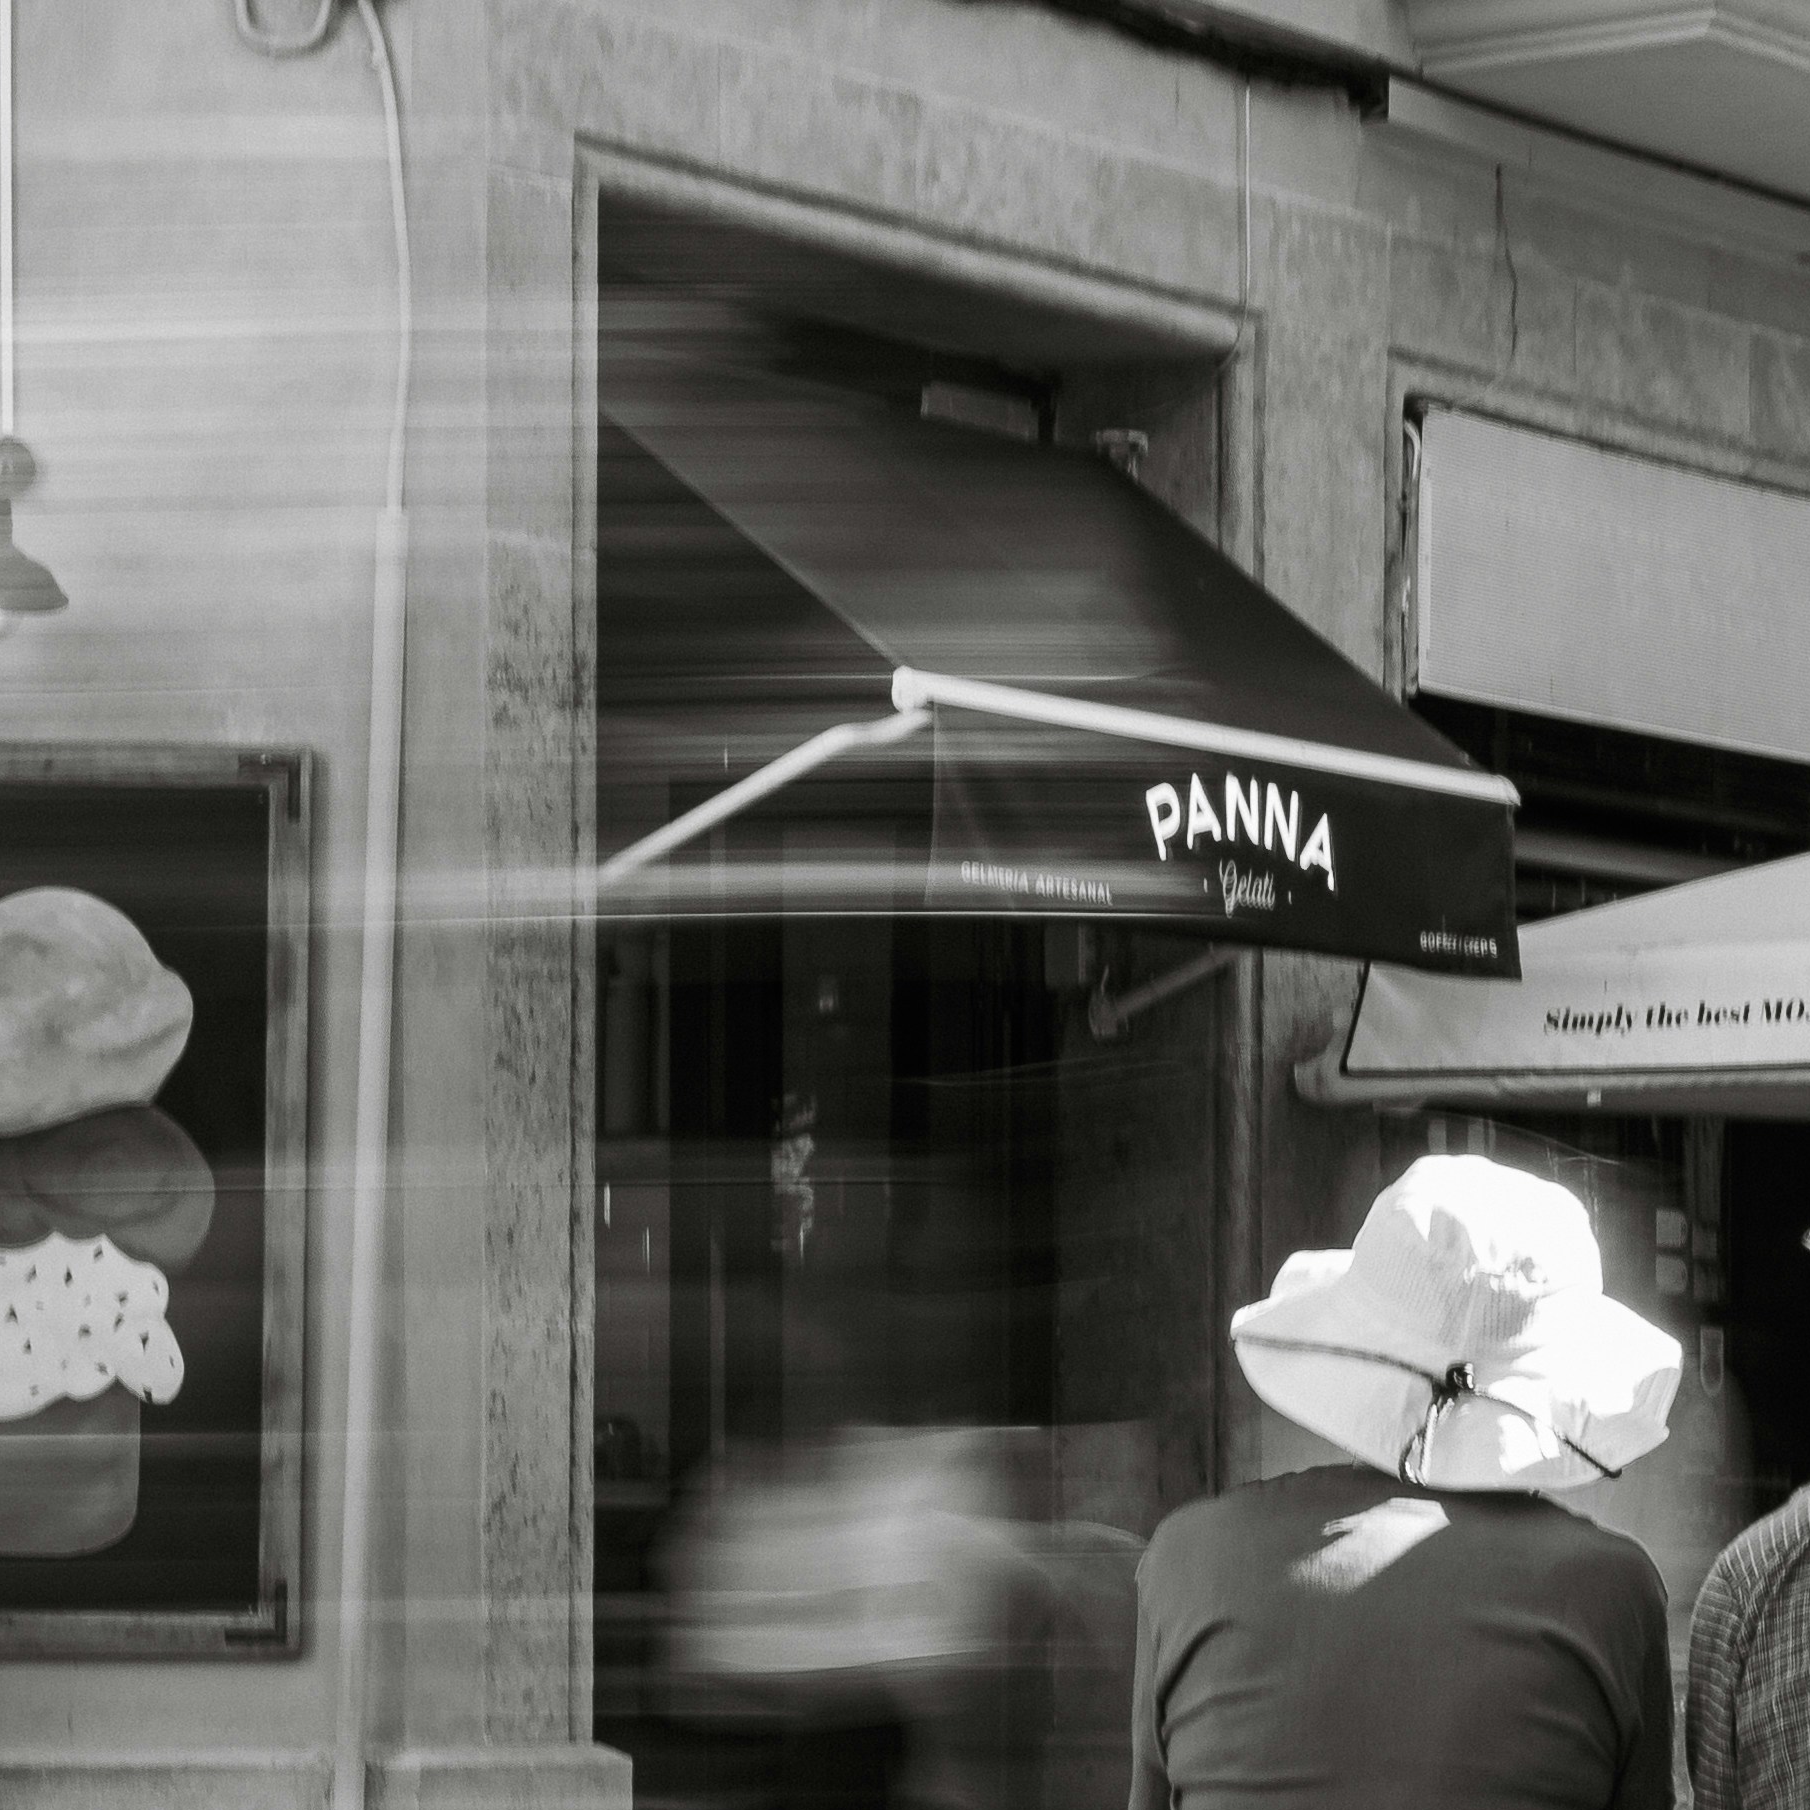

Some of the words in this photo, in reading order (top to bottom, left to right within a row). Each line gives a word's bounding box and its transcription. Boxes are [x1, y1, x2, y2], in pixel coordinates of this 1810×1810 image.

[1145, 772, 1336, 892] PANNA
[1544, 1005, 1634, 1037] Simply
[1646, 1001, 1690, 1029] the
[1696, 999, 1751, 1027] best
